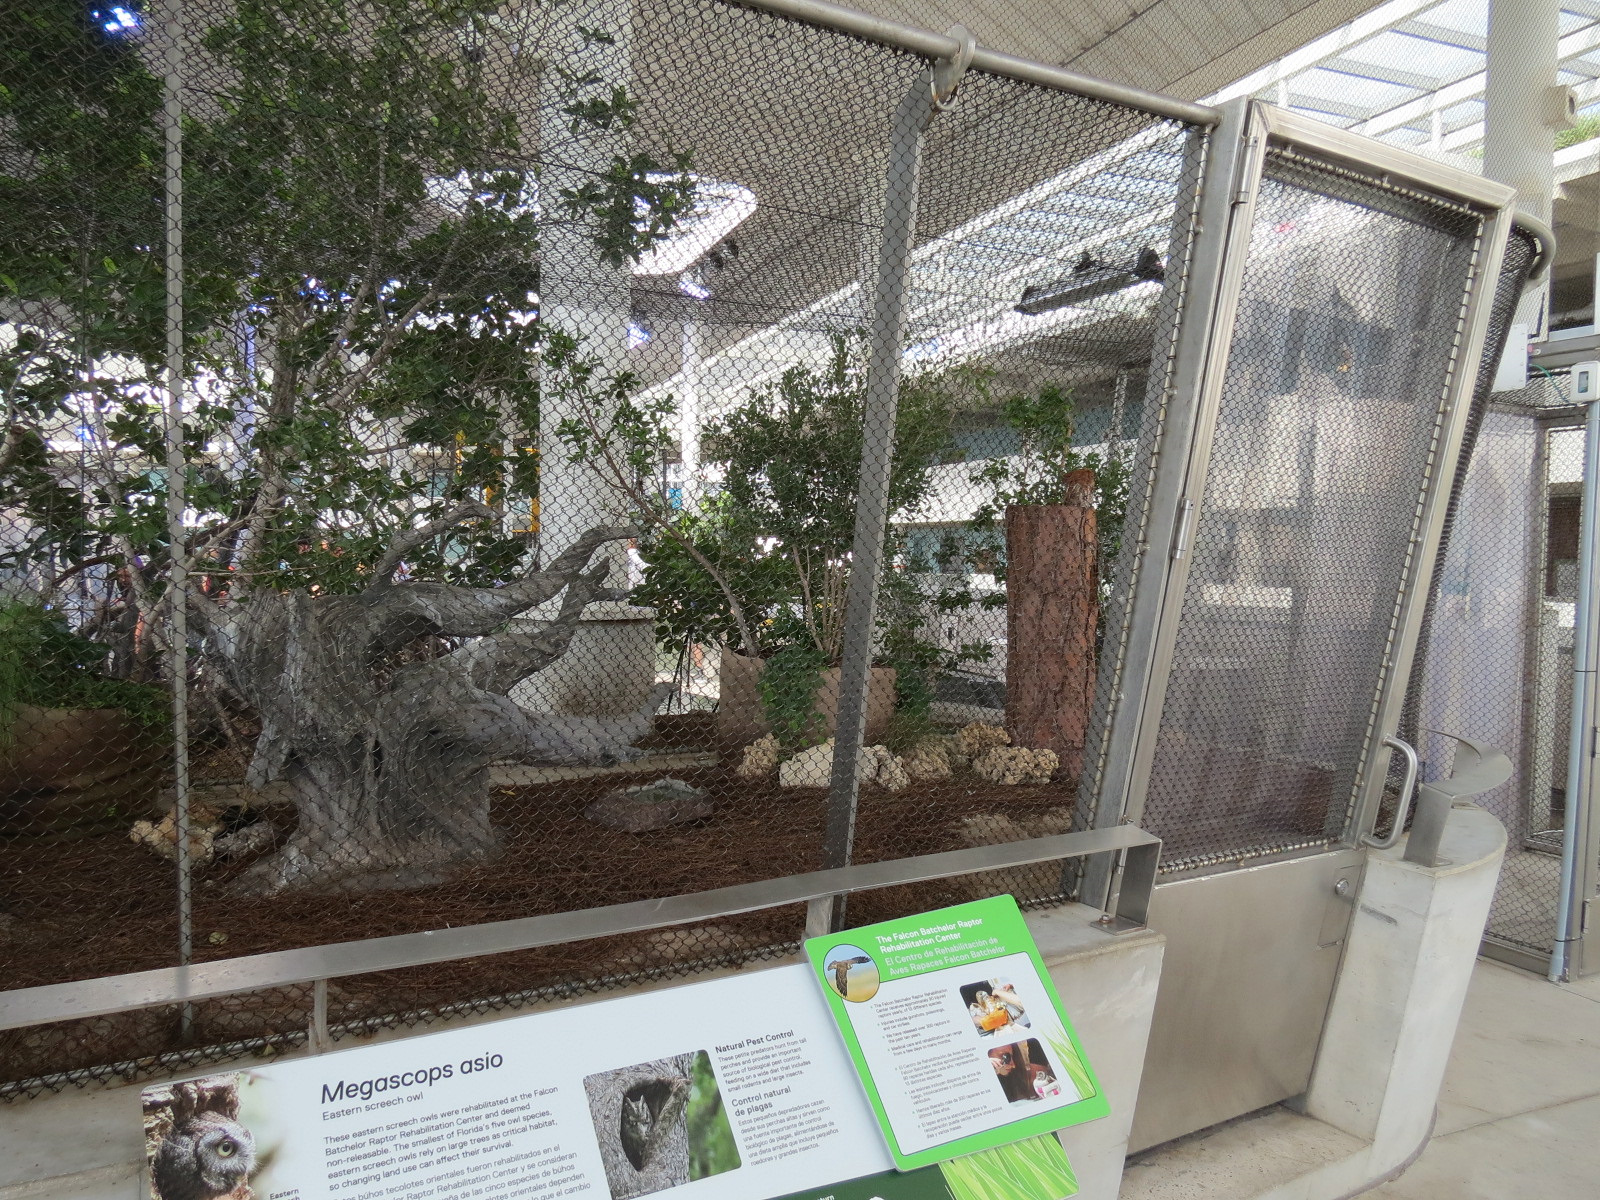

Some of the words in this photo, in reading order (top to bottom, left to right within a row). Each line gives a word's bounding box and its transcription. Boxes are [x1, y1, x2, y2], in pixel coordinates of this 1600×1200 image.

[876, 936, 892, 944] The
[893, 931, 920, 940] Falcon
[920, 924, 956, 936] Batchelor
[957, 919, 982, 928] Raptor
[880, 938, 935, 953] Rehabilitation
[935, 933, 961, 942] Center
[885, 957, 894, 966] El
[895, 954, 923, 963] Centro
[924, 950, 934, 958] de
[934, 940, 988, 955] Rehabilitación
[890, 967, 910, 976] Aves
[910, 960, 944, 971] Rapaces
[944, 954, 970, 963] Falcon
[970, 946, 1005, 958] Batchelor
[715, 1041, 745, 1053] Natural
[746, 1037, 764, 1046] Pest
[766, 1030, 794, 1042] Control
[321, 1064, 453, 1104] Megascops
[460, 1052, 503, 1074] asio
[323, 1107, 362, 1120] Eastern
[365, 1097, 404, 1111] screech
[407, 1092, 424, 1102] owl
[732, 1093, 762, 1107] Control
[764, 1086, 791, 1099] natural
[747, 1102, 773, 1115] plagas
[324, 1134, 350, 1144] These
[352, 1126, 384, 1138] eastern
[386, 1118, 418, 1130] screech
[420, 1114, 438, 1122] owls
[440, 1110, 460, 1118] were
[462, 1097, 509, 1113] rehabilitated
[534, 1087, 558, 1097] Falcon
[325, 1142, 366, 1156] Batchelor
[369, 1135, 397, 1146] Raptor
[400, 1122, 454, 1138] Rehabilitation
[456, 1115, 483, 1125] Center
[485, 1110, 499, 1119] and
[501, 1103, 531, 1115] deemed
[327, 1148, 391, 1167] non-releasable.
[393, 1143, 410, 1151] The
[412, 1135, 444, 1147] smallest
[446, 1131, 454, 1139] of
[507, 1116, 521, 1125] owl
[523, 1111, 552, 1122] species,
[328, 1167, 361, 1179] eastern
[363, 1157, 396, 1171] screech
[398, 1152, 417, 1162] owls
[419, 1148, 434, 1157] rely
[448, 1141, 468, 1150] large
[470, 1136, 490, 1144] trees
[502, 1125, 528, 1137] critical
[529, 1120, 558, 1130] habitat,
[342, 1174, 381, 1188] changing
[383, 1167, 401, 1178] land
[402, 1165, 417, 1173] use
[419, 1160, 435, 1169] can
[436, 1154, 460, 1165] affect
[462, 1149, 480, 1158] their
[386, 1180, 424, 1194] tecolotes
[426, 1170, 465, 1184] orientales
[467, 1163, 493, 1173] fueron
[494, 1150, 541, 1166] rehabilitados
[554, 1144, 560, 1152] el
[437, 1175, 491, 1193] Rehabilitation
[492, 1167, 518, 1178] Center
[538, 1153, 577, 1167] consideran
[472, 1188, 483, 1196] las
[485, 1182, 506, 1192] cinco
[508, 1173, 540, 1186] especies
[552, 1164, 575, 1175] búhos
[270, 1189, 299, 1200] Eastern
[510, 1183, 547, 1198] orientales
[549, 1173, 585, 1187] dependen
[556, 1189, 563, 1197] el
[564, 1183, 591, 1194] cambio
